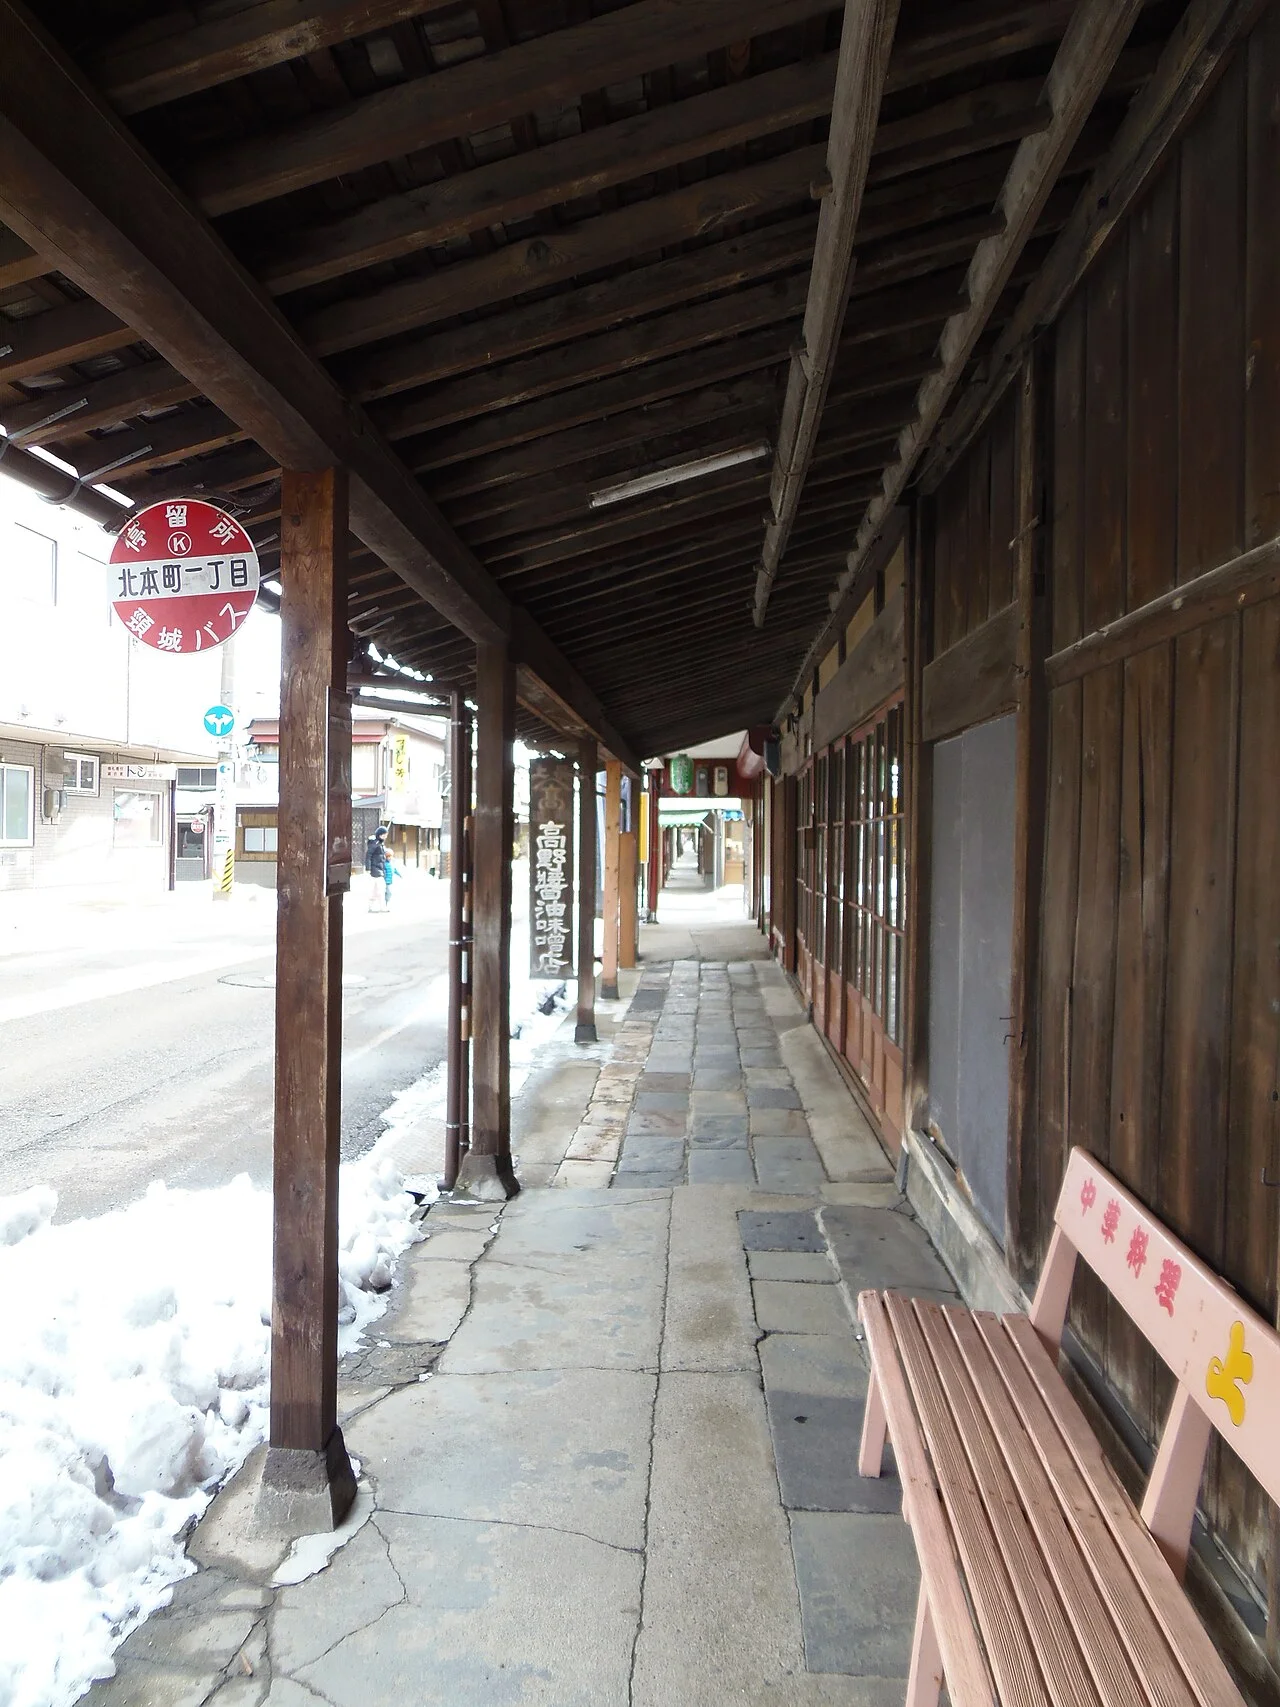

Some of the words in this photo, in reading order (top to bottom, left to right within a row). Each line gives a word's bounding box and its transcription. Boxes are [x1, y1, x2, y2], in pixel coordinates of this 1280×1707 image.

[118, 559, 248, 597] 北本町一丁目
[126, 602, 248, 652] 頸城バス
